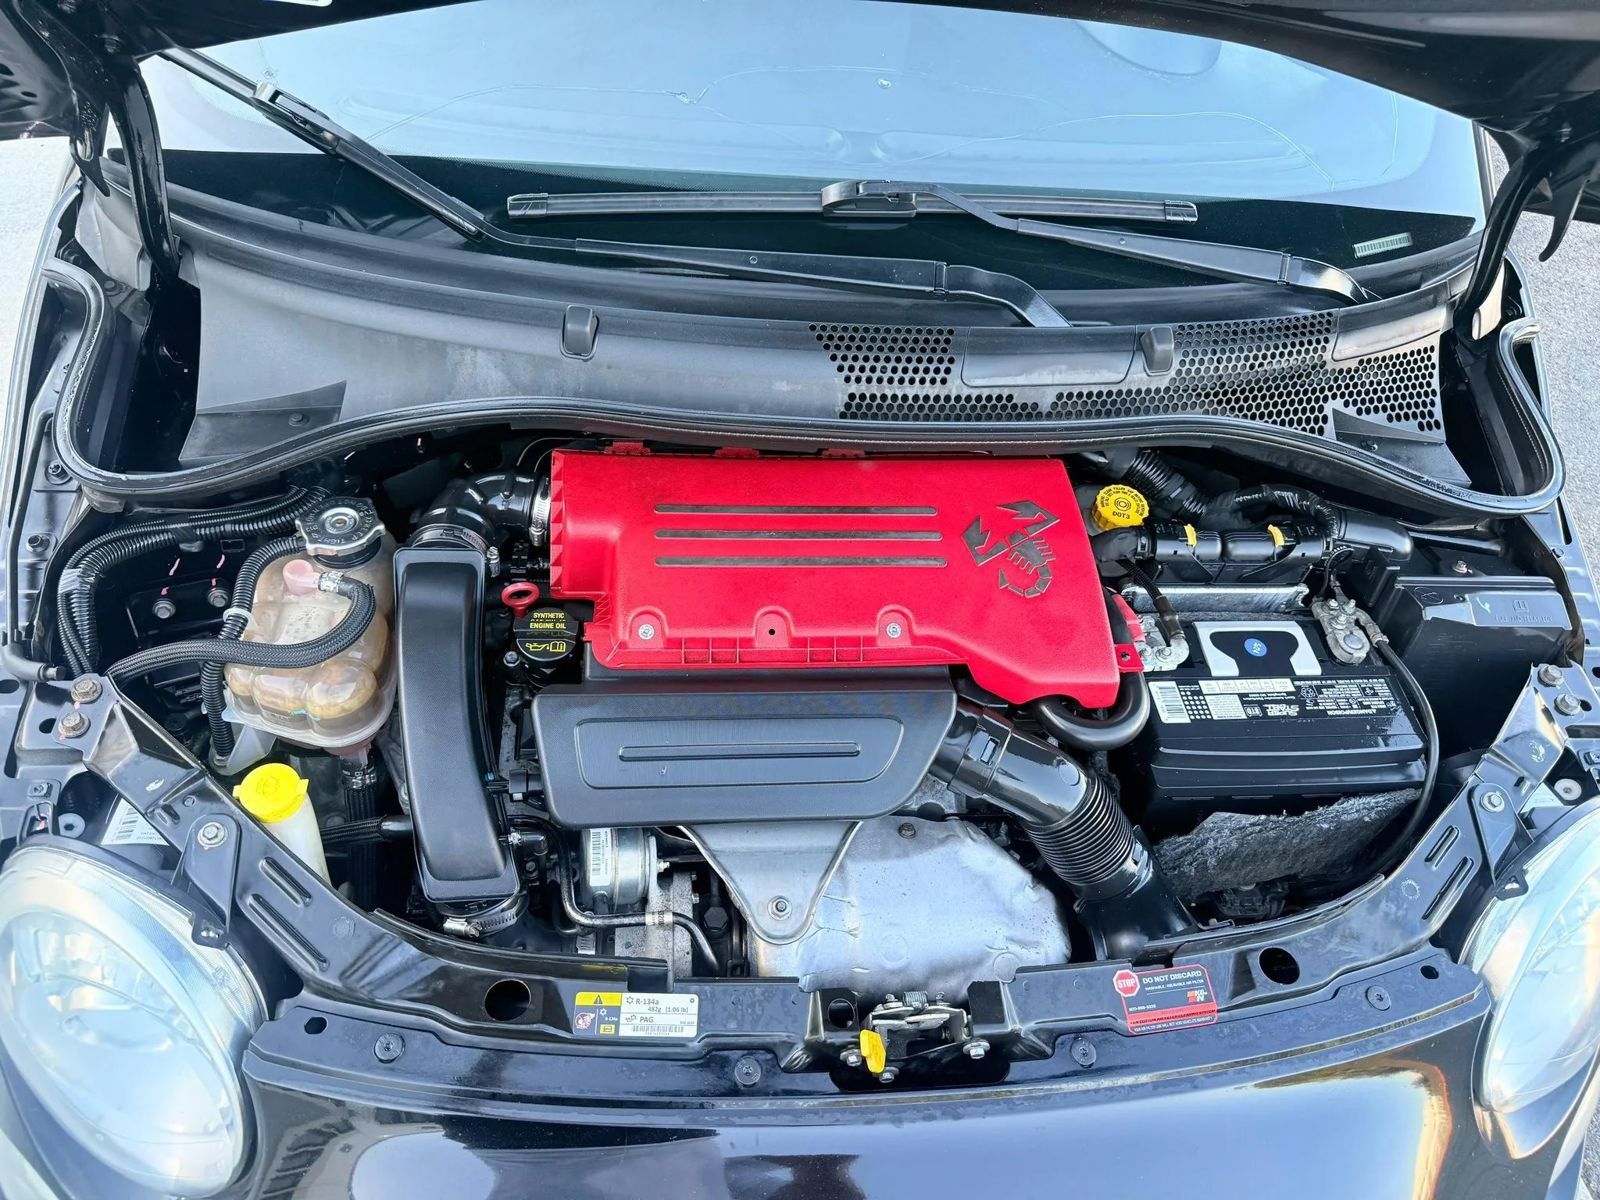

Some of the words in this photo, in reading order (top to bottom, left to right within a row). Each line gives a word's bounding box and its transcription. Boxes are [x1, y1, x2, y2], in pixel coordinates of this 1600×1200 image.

[1112, 510, 1130, 519] DOT3
[1170, 970, 1202, 980] DISCARD
[1117, 978, 1136, 989] STOP
